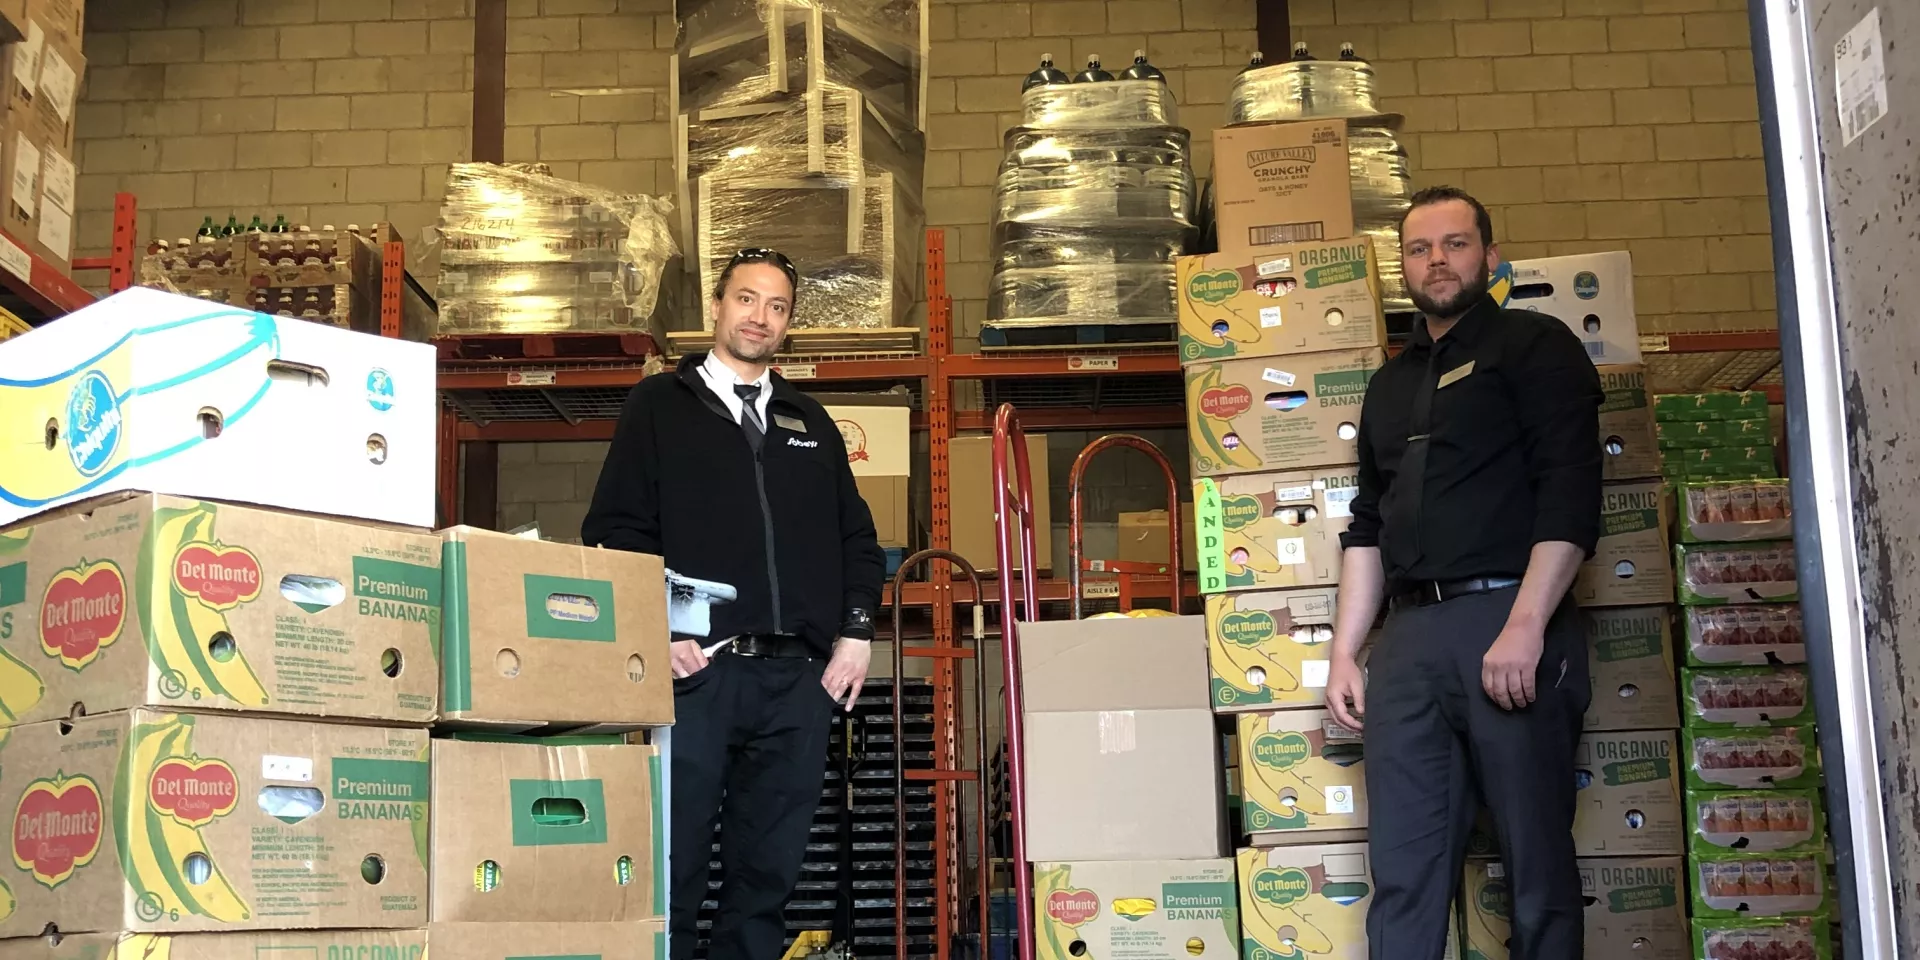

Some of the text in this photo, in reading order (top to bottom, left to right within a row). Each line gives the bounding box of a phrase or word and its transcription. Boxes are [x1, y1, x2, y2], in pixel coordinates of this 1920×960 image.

[1249, 146, 1315, 164] NATURE VALLEY
[1253, 164, 1311, 178] CRUNCHY
[1258, 183, 1308, 193] OATS & HONEY
[1299, 244, 1367, 267] ORGANIC
[1317, 263, 1352, 277] PREMIUM
[1318, 272, 1355, 285] BANANAS
[1192, 280, 1238, 294] Del Monte
[1203, 394, 1249, 408] Del Monte
[1227, 504, 1257, 516] Monte
[1605, 511, 1644, 525] PREMIUM
[1606, 520, 1646, 534] BANANAS
[182, 560, 257, 585] Del Monte
[358, 575, 428, 602] Premium
[1086, 586, 1103, 594] AISLE
[46, 590, 120, 629] Del Monte
[359, 599, 438, 626] BANANAS
[275, 624, 345, 637] VARIETY: CAVENDISH
[1224, 619, 1272, 635] Del Monte
[1590, 616, 1661, 636] ORGANIC
[275, 632, 306, 642] MINIMUM
[307, 634, 335, 644] LENGTH:
[275, 641, 289, 649] NET
[303, 643, 312, 652] 40
[192, 687, 202, 701] 6
[397, 693, 423, 701] PRODUCT
[400, 701, 433, 711] GUATEMALA
[388, 739, 406, 747] STORE
[1257, 742, 1306, 756] Del Monte
[1597, 740, 1669, 760] ORGANIC
[1616, 761, 1655, 773] PREMIUM
[1617, 770, 1658, 783] BANANAS
[157, 777, 233, 797] Del Monte
[338, 777, 412, 797] Premium
[177, 797, 211, 812] Quality
[338, 802, 423, 822] BANANAS
[19, 809, 98, 841] Del Monte
[285, 836, 325, 844] CAVENDISH
[252, 844, 283, 852] MINIMUM
[285, 844, 315, 853] LENGTH:
[252, 853, 266, 861] NET
[1601, 867, 1676, 886] ORGANIC
[1256, 879, 1306, 892] Del Monte
[380, 895, 405, 903] PRODUCT
[1049, 899, 1097, 912] Del Monte
[1166, 894, 1222, 907] Premium
[381, 903, 418, 911] GUATEMALA
[169, 907, 180, 922] 6
[1167, 909, 1233, 921] BANANAS
[327, 944, 421, 960] ORGANIC
